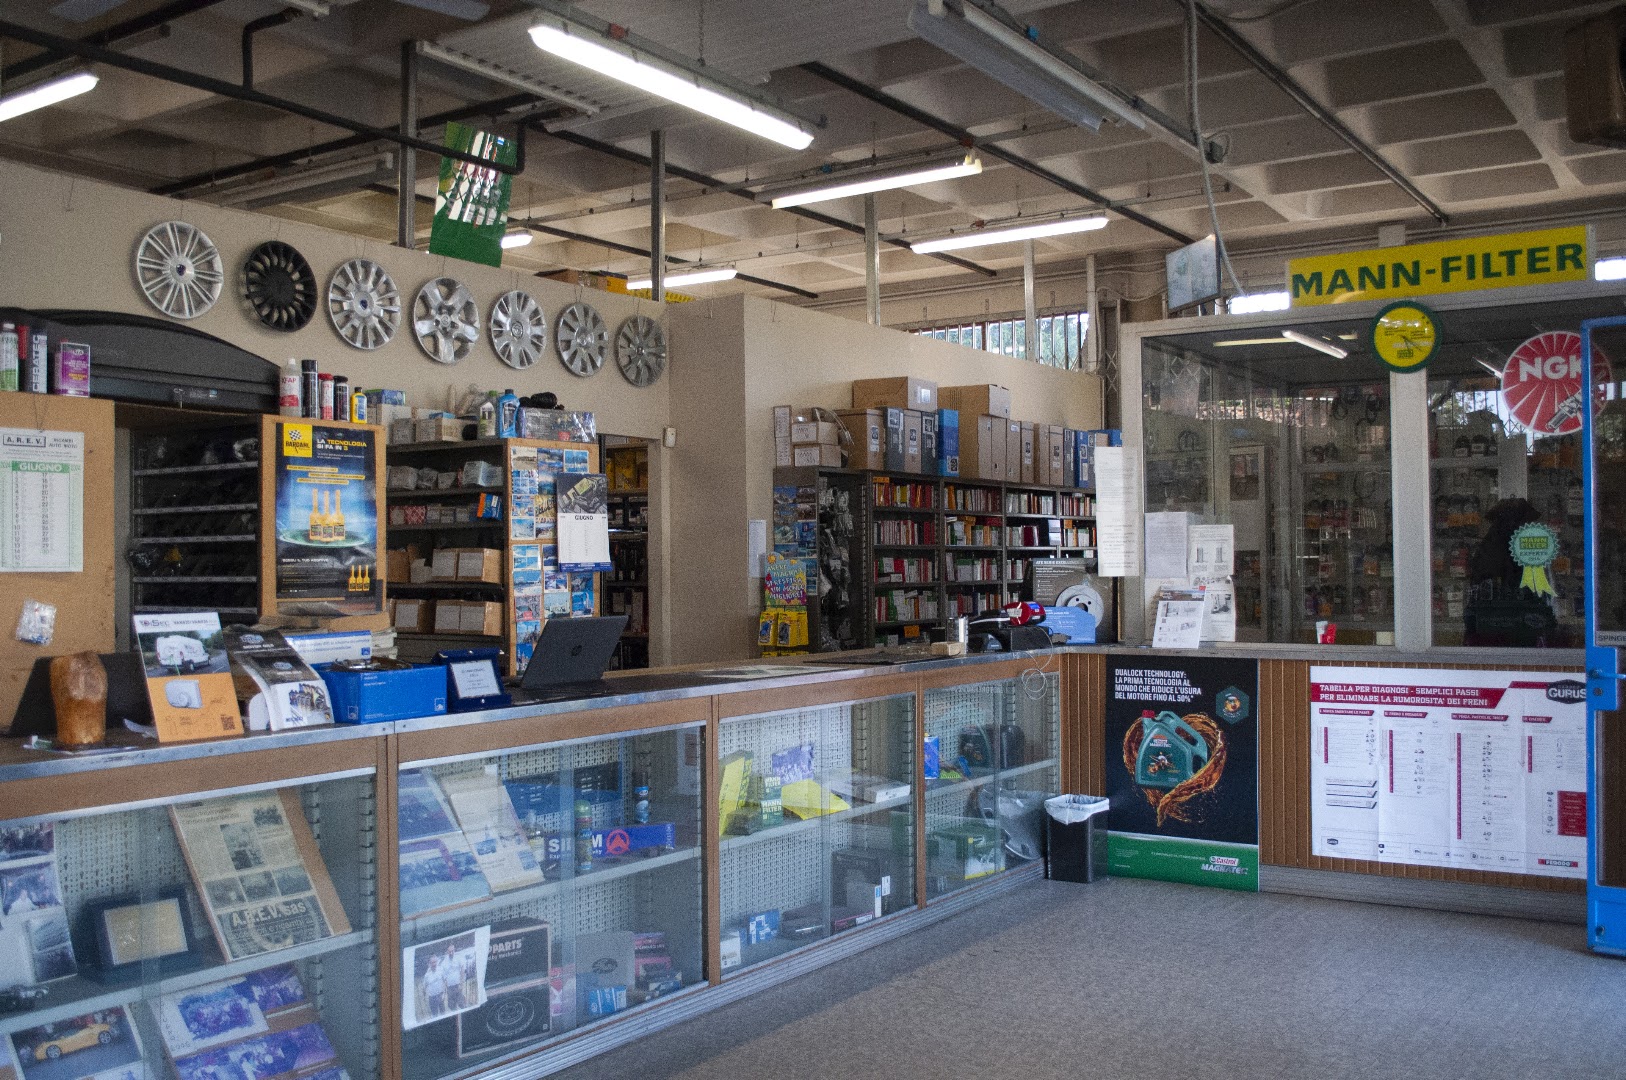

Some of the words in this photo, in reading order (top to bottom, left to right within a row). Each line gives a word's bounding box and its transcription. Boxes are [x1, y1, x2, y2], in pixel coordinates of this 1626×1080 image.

[1292, 243, 1585, 299] MANN-FILTER
[327, 439, 367, 447] TECNOLOGIA
[19, 462, 63, 472] GIUGNO
[1115, 668, 1143, 677] DUALOCK
[1144, 670, 1187, 678] TECHNOLOGY:
[1115, 676, 1123, 684] LA
[1123, 677, 1143, 685] PRIMA
[1144, 678, 1182, 686] TECNOLOGIA
[1182, 679, 1191, 687] AL
[1115, 684, 1138, 692] MONDO
[1138, 685, 1151, 693] CHE
[1151, 686, 1174, 694] RIDUCE
[1174, 686, 1202, 695] L'USURA
[1319, 684, 1353, 692] TABELLA
[1355, 685, 1370, 693] PER
[1372, 686, 1409, 694] DIAGNOSI
[1415, 687, 1453, 695] SEMPLICI
[1455, 688, 1479, 696] PASSI
[1548, 687, 1587, 699] GURUS
[1115, 692, 1126, 700] DEL
[1127, 692, 1152, 700] MOTORE
[1152, 693, 1168, 701] FINO
[1168, 694, 1176, 702] AL
[1319, 693, 1334, 701] PER
[1336, 694, 1379, 702] ELIMINARE
[1380, 695, 1391, 703] LA
[1393, 696, 1445, 705] RUMOROSITA'
[1447, 697, 1460, 705] DEI
[1463, 698, 1488, 706] FRENI
[762, 805, 782, 813] FILTER
[548, 833, 603, 853] SIM
[1215, 857, 1237, 866] Castrol
[1200, 863, 1249, 875] MAGNATEC
[286, 901, 307, 915] sas
